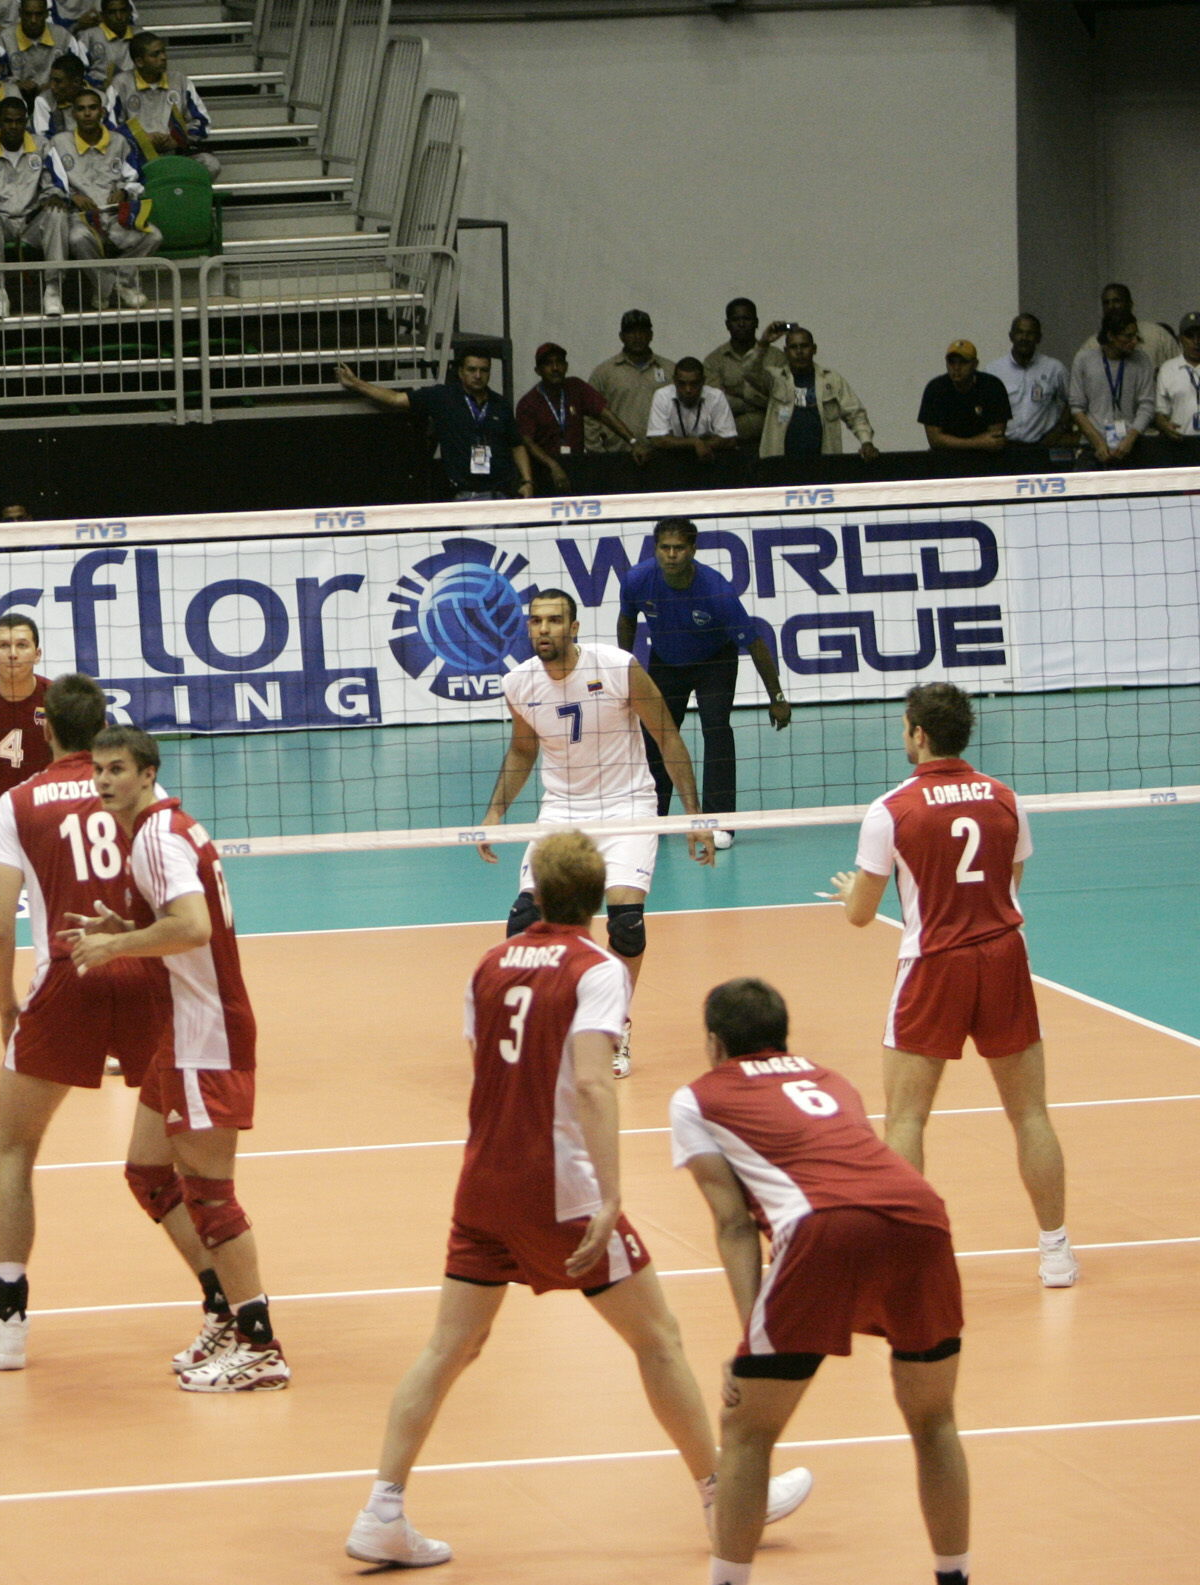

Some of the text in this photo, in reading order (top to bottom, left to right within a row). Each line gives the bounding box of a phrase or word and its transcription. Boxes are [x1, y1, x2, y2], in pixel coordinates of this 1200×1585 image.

[785, 489, 835, 507] FIVB
[1016, 478, 1066, 495] FIVB
[314, 511, 366, 529] FIVB
[551, 500, 602, 518] FIVB
[75, 522, 127, 540] FIVB
[447, 674, 504, 696] FIVB
[556, 702, 583, 744] 7
[922, 782, 994, 805] LOMACZ
[59, 811, 122, 881] 18
[951, 816, 984, 883] 2
[499, 945, 567, 968] JAROSZ
[499, 985, 533, 1064] 3
[781, 1080, 839, 1116] 6
[625, 1234, 641, 1257] 3
